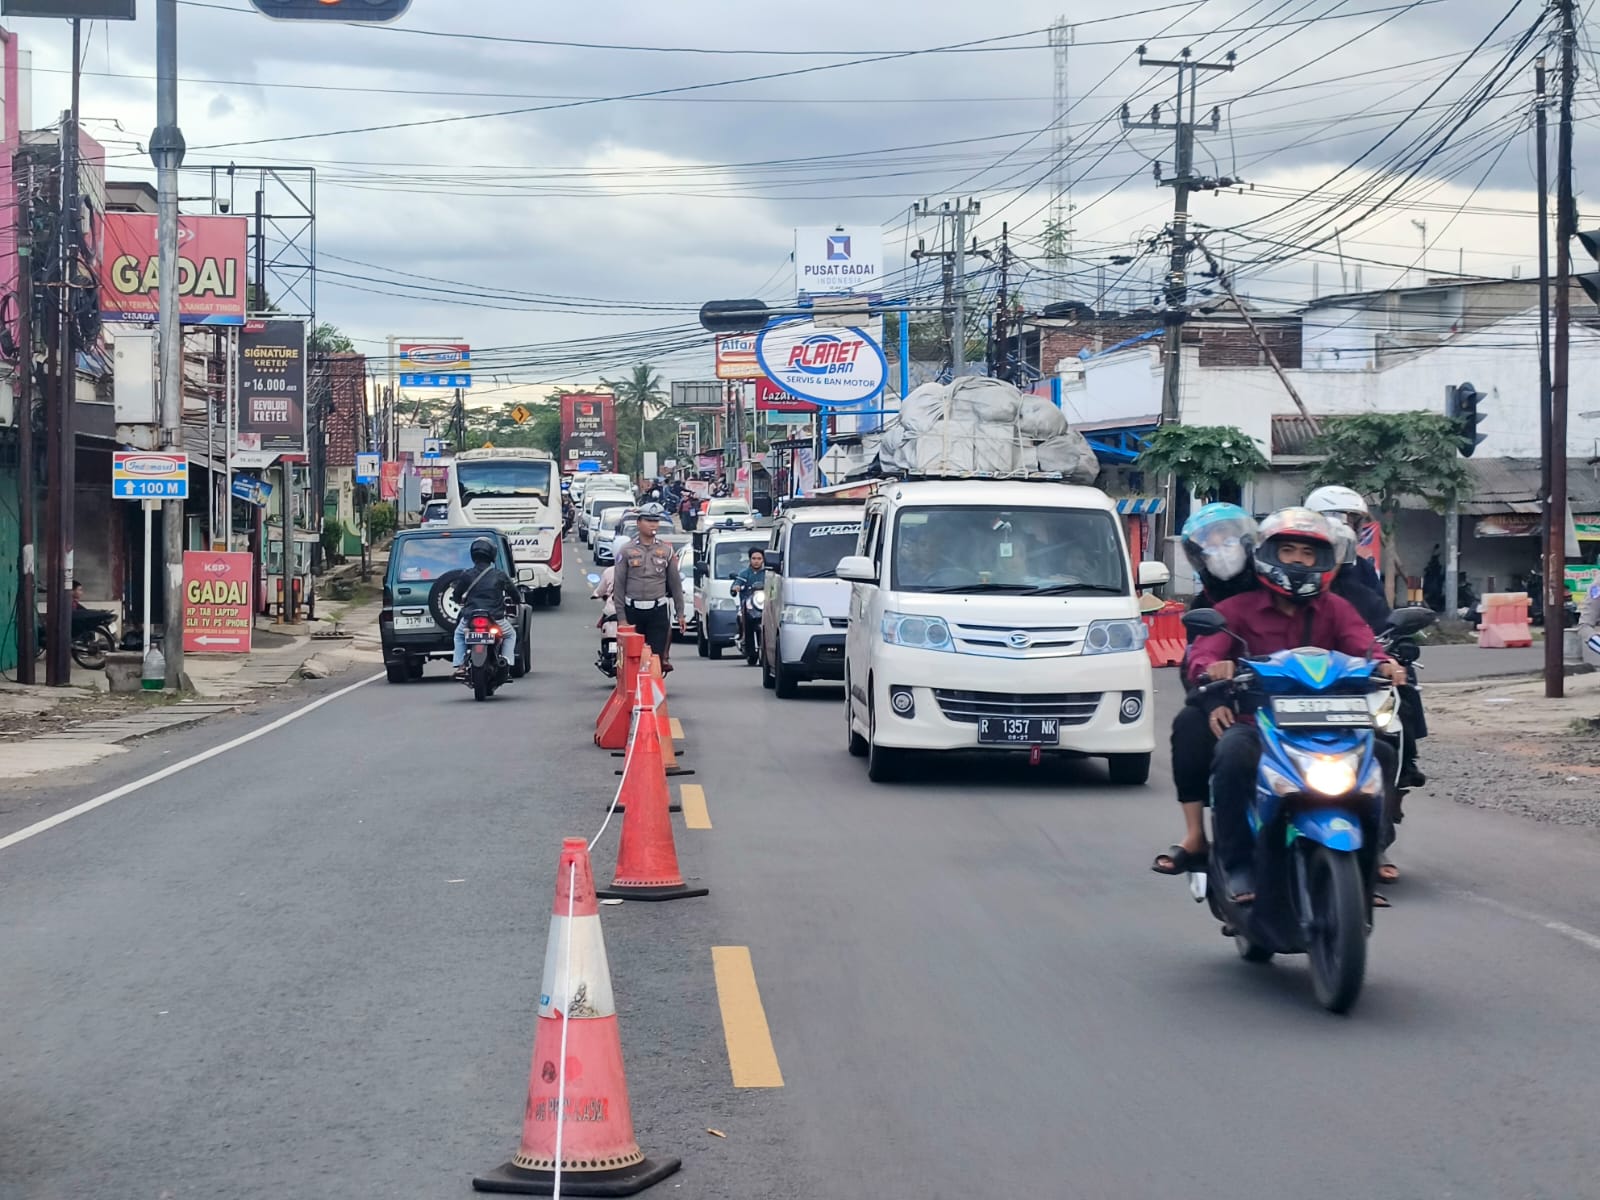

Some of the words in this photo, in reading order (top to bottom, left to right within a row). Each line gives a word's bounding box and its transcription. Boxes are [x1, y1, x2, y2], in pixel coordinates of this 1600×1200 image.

[112, 254, 236, 297] GADAI
[804, 265, 839, 276] PUSAT
[841, 264, 874, 275] GADAI
[244, 349, 298, 358] SIGNATURE
[788, 341, 863, 366] PLANET
[828, 363, 853, 374] BAN
[252, 379, 285, 391] 16.000
[786, 376, 814, 384] SERVIS
[816, 377, 821, 385] &
[824, 377, 841, 386] BAN
[843, 379, 875, 388] MOTOR
[253, 400, 287, 411] REVOLUSI
[253, 411, 287, 422] KRETEK
[139, 482, 163, 494] 100
[167, 482, 178, 494] M
[187, 580, 248, 605] GADAI
[215, 608, 239, 617] LAPTOP
[202, 619, 210, 627] TV
[981, 719, 989, 734] R
[1002, 719, 1030, 735] 1357
[1041, 720, 1056, 735] NK
